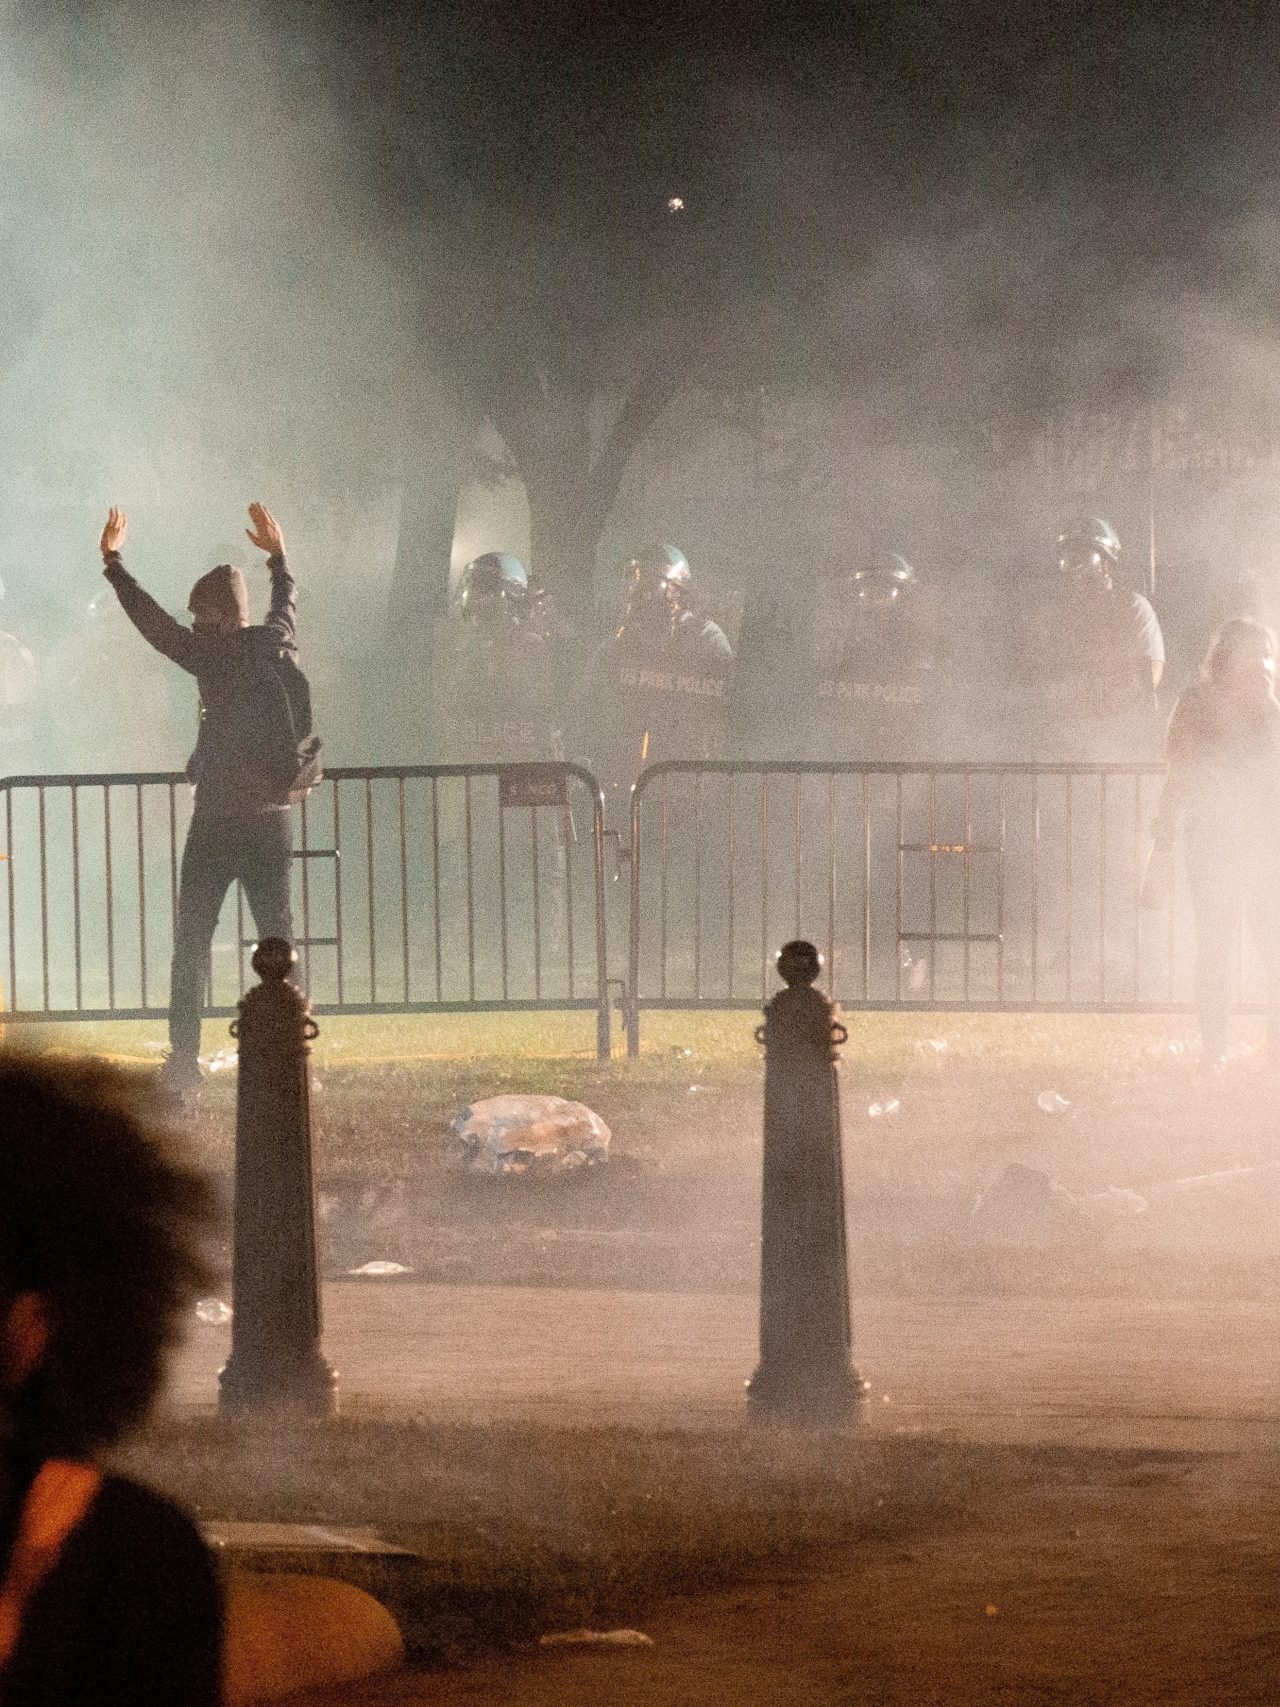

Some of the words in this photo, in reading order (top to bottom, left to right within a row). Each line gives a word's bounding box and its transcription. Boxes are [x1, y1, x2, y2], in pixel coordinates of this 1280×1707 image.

[676, 676, 724, 698] POLICE
[873, 684, 921, 703] POLICE
[446, 718, 534, 744] POLICE
